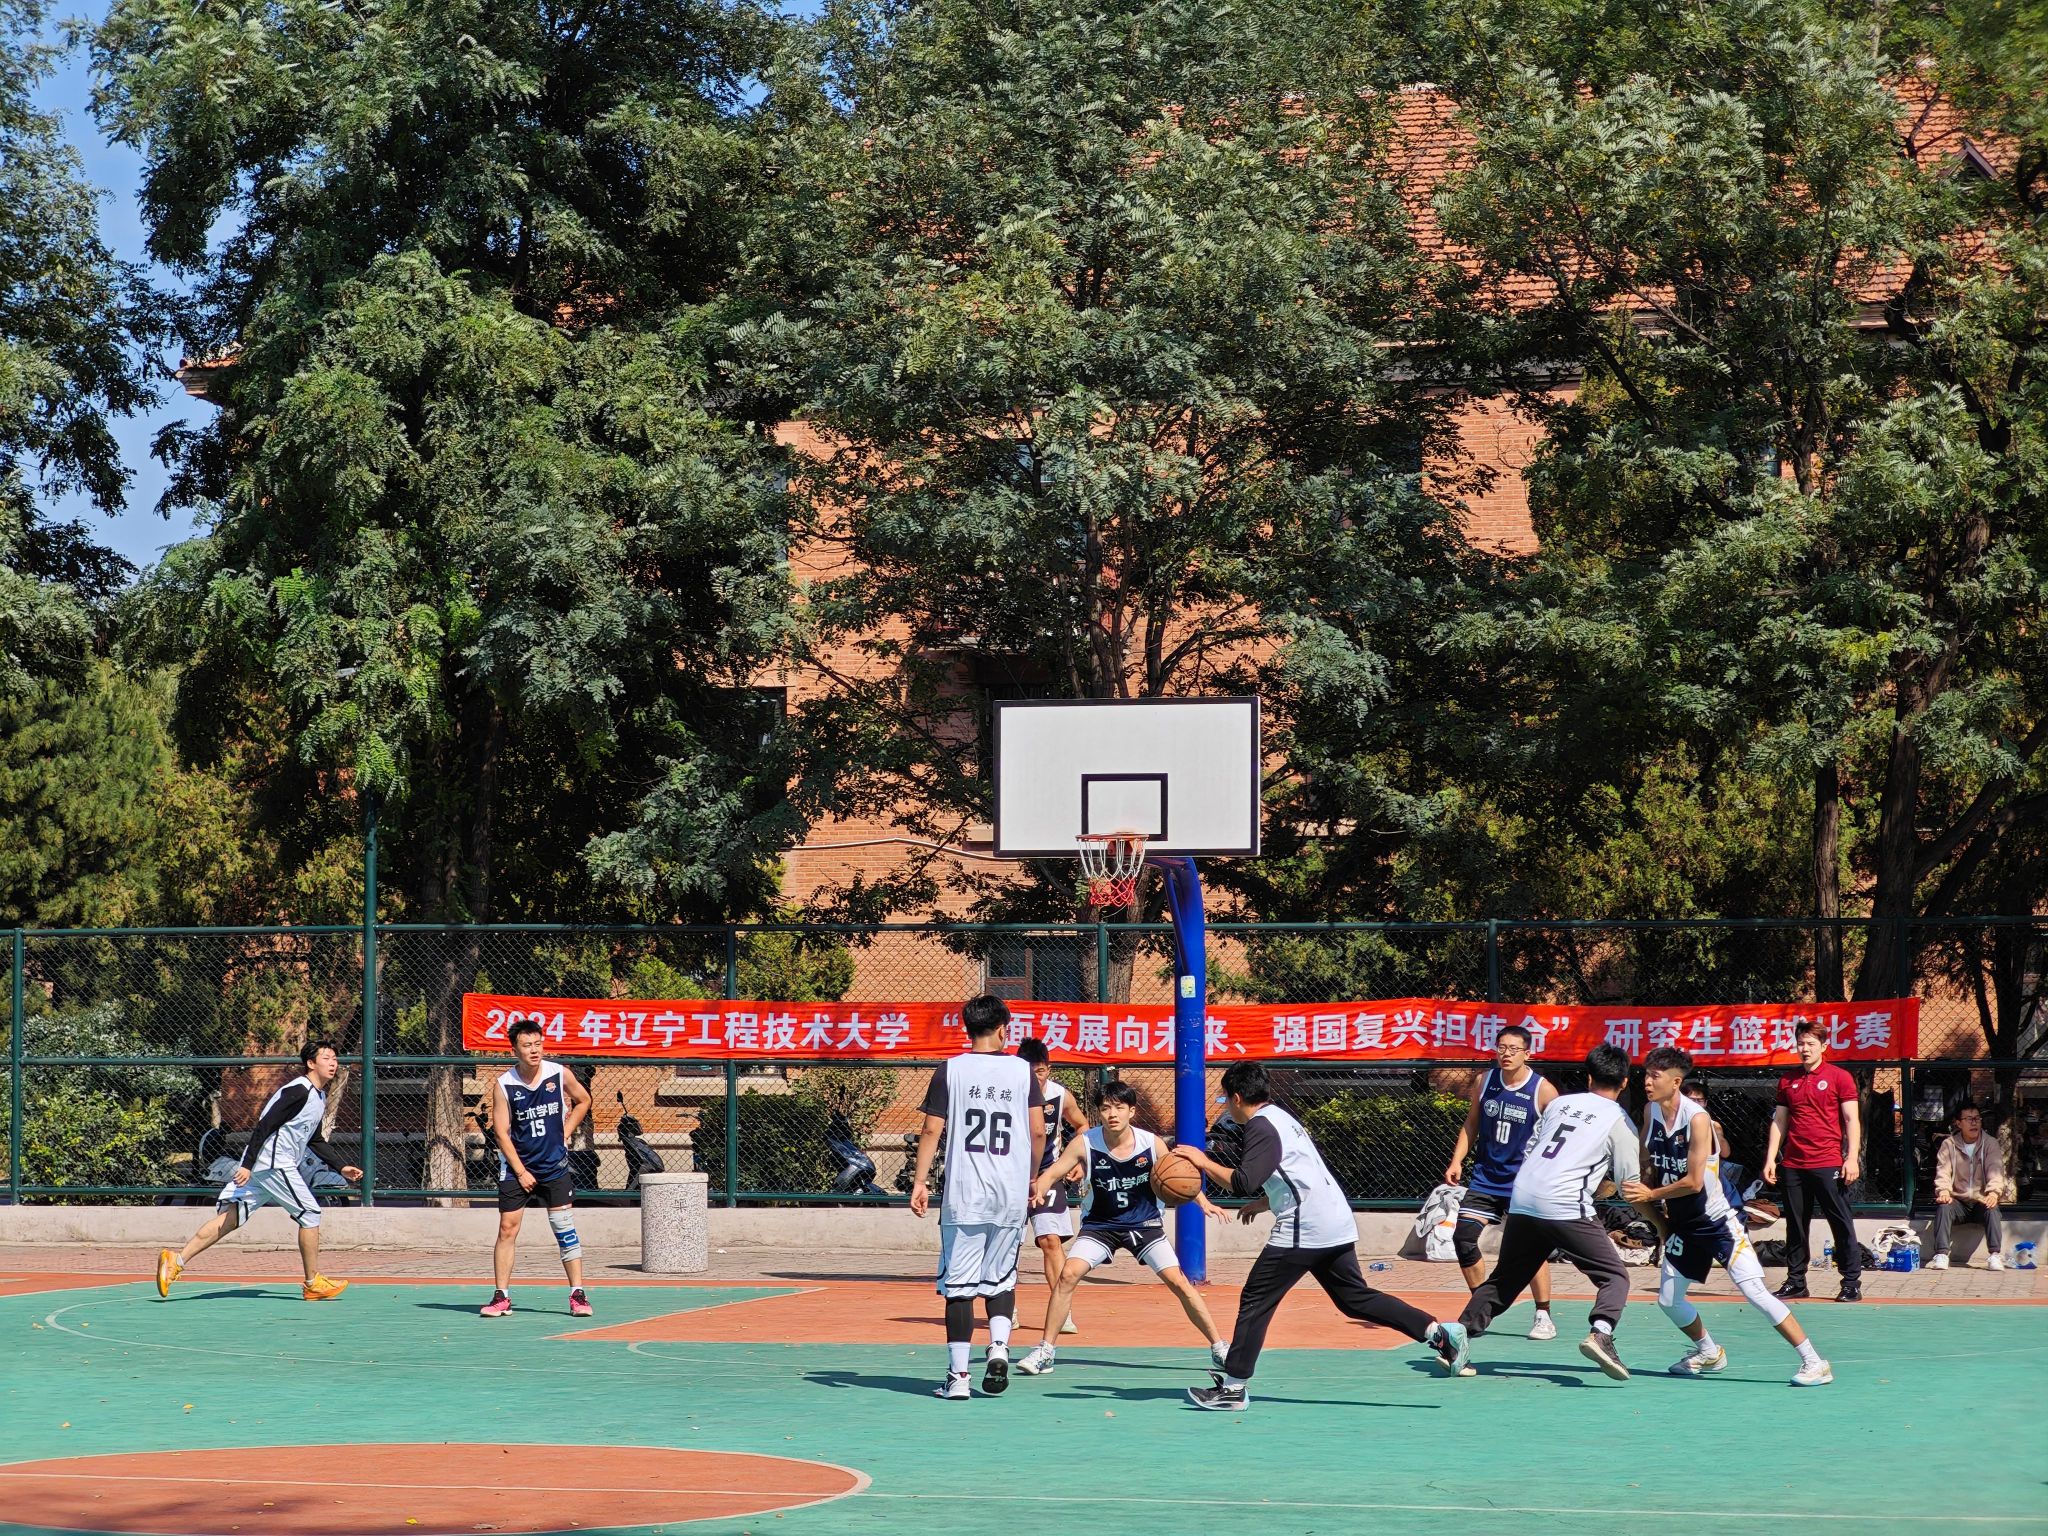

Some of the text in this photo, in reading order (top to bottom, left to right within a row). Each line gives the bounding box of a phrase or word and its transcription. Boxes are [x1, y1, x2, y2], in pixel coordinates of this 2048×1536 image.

[943, 1009, 1570, 1056] “面发展向未来、强国复兴担使命”
[1604, 1011, 1893, 1057] 研究生篮球比赛
[529, 1118, 546, 1138] 15
[964, 1107, 1013, 1157] 26
[1495, 1120, 1511, 1145] 10
[1541, 1122, 1577, 1160] 5
[1116, 1191, 1129, 1209] 5
[1665, 1232, 1684, 1257] 45
